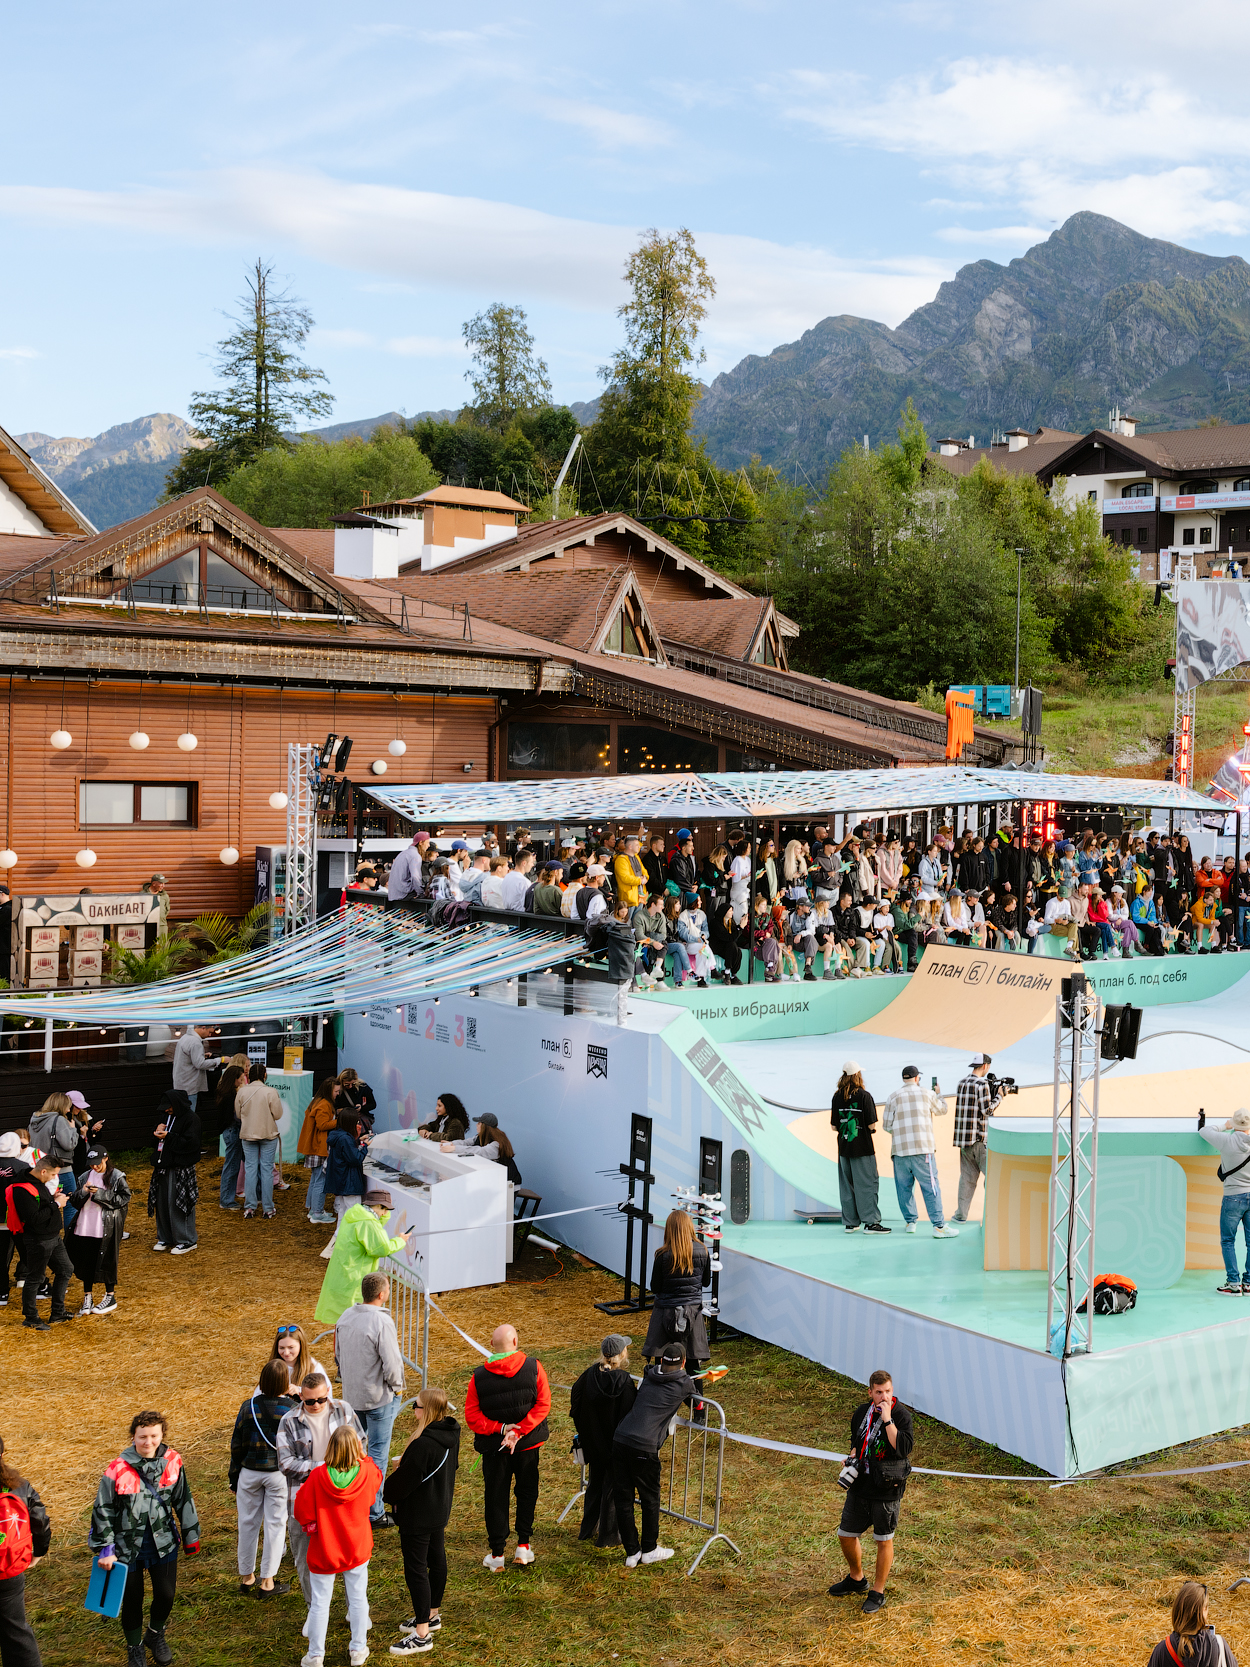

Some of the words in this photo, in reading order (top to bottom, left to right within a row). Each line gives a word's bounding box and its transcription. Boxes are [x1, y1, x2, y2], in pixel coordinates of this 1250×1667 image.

[89, 902, 147, 918] OAKHEART
[927, 962, 965, 979] план
[968, 964, 983, 983] б.
[996, 967, 1053, 991] билайн
[1099, 976, 1124, 988] план
[1127, 973, 1137, 986] б.
[1139, 974, 1160, 986] под
[1162, 969, 1188, 983] себя
[398, 1003, 407, 1034] 1
[732, 1000, 810, 1019] вибрациях
[425, 1007, 436, 1041] 2
[453, 1013, 465, 1048] 3
[541, 1038, 561, 1053] план
[562, 1041, 572, 1056] б.
[547, 1060, 565, 1072] билайн
